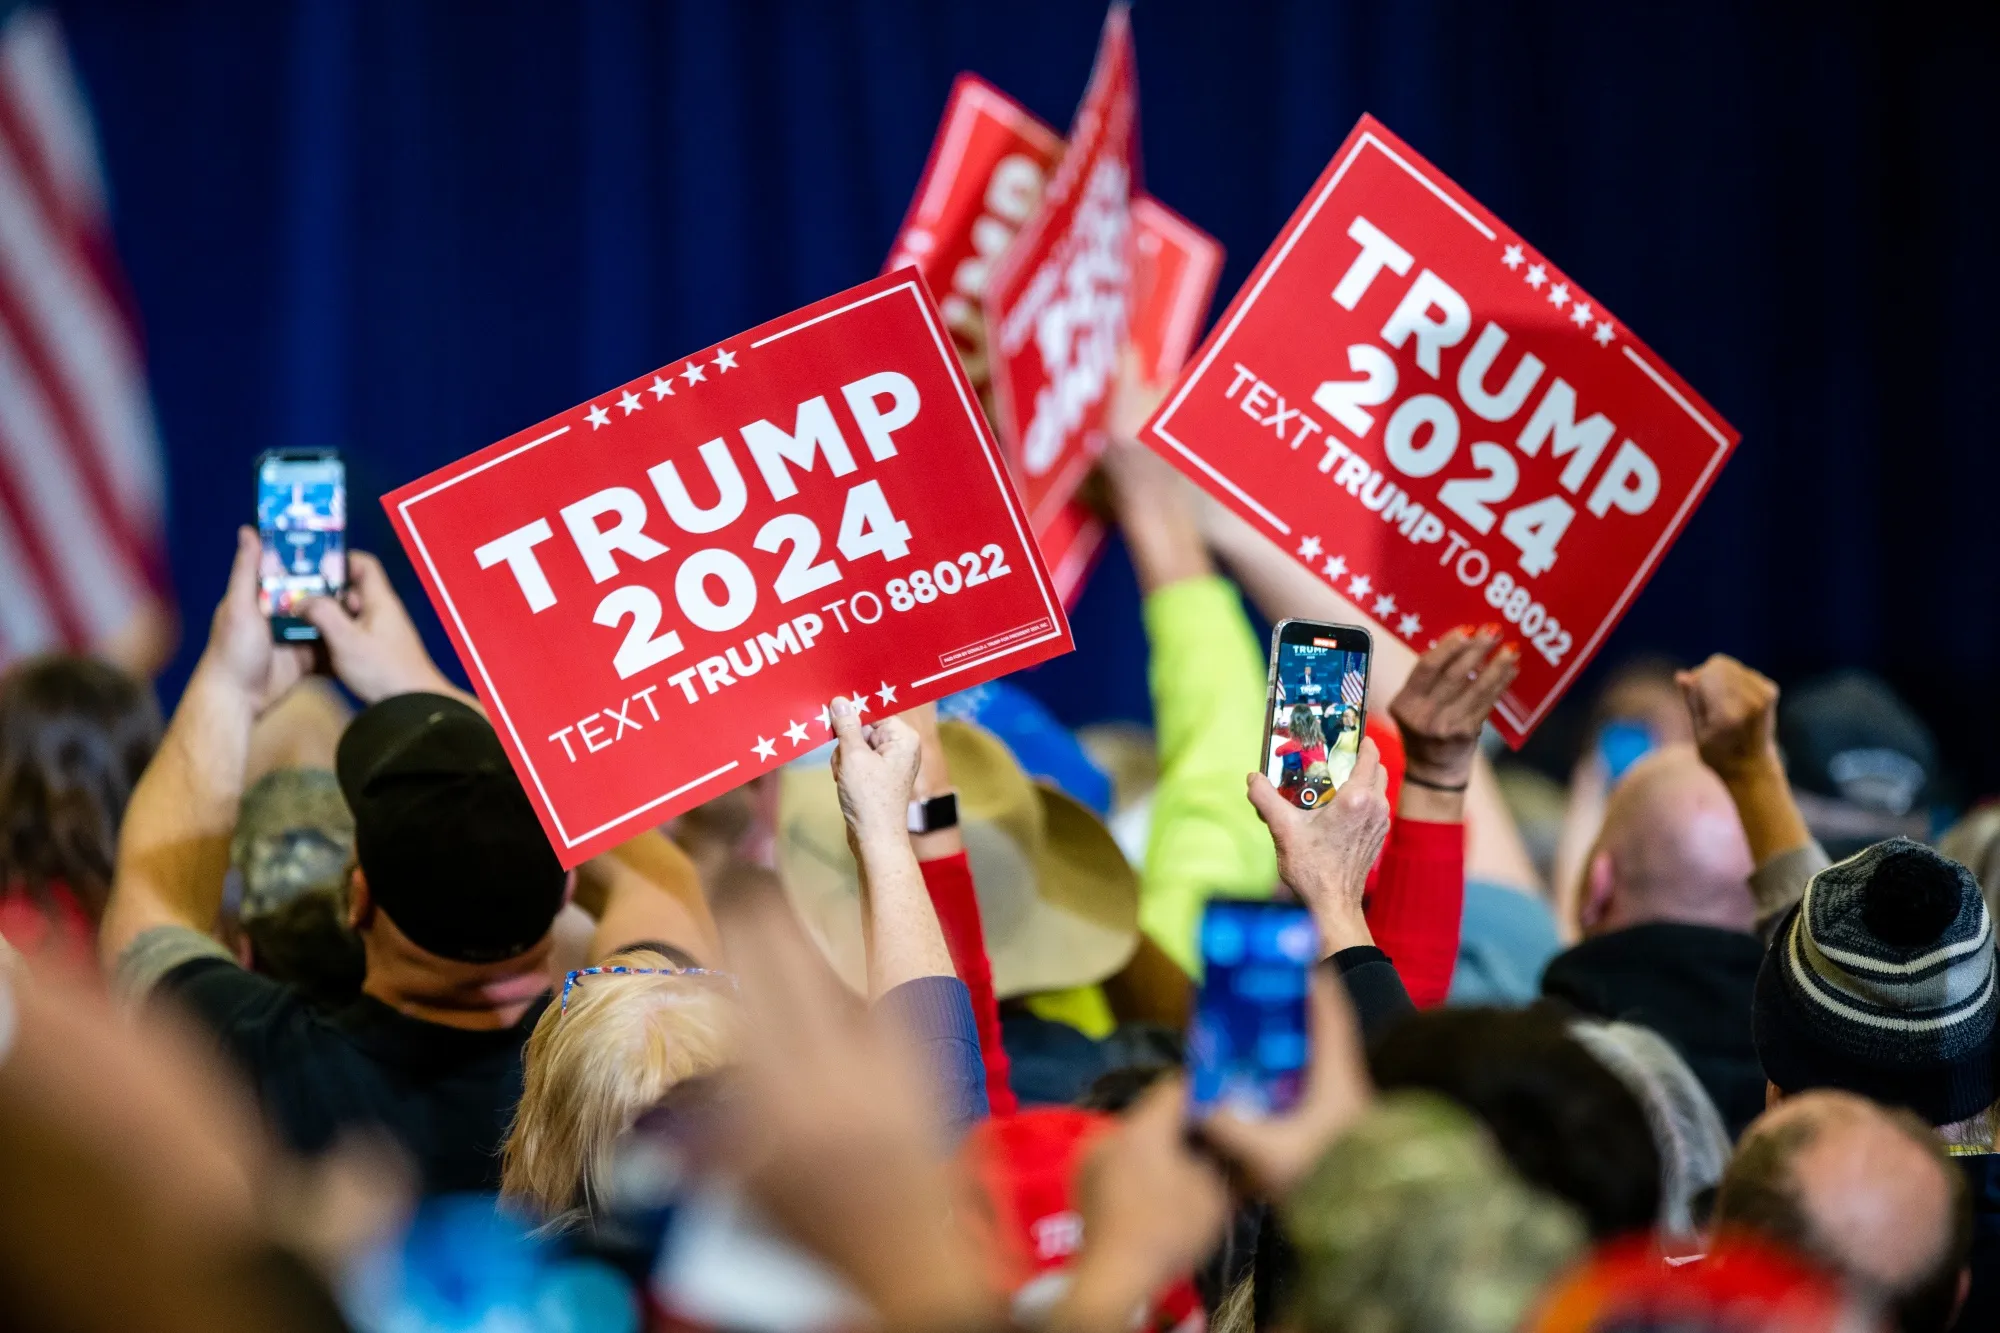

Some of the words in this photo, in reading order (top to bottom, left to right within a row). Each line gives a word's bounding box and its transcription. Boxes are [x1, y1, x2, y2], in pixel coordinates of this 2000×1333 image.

[1312, 344, 1575, 577] 2024
[1332, 216, 1661, 518] TRUMP
[474, 372, 920, 614] TRUMP
[593, 480, 912, 680] 2024
[1225, 363, 1322, 450] TEXT
[1318, 435, 1444, 543] TRUMP
[1441, 532, 1489, 586] TO
[1486, 573, 1573, 665] 88022
[549, 685, 660, 762] TEXT
[668, 614, 823, 704] TRUMP
[822, 591, 882, 633] TO
[886, 544, 1011, 611] 88022
